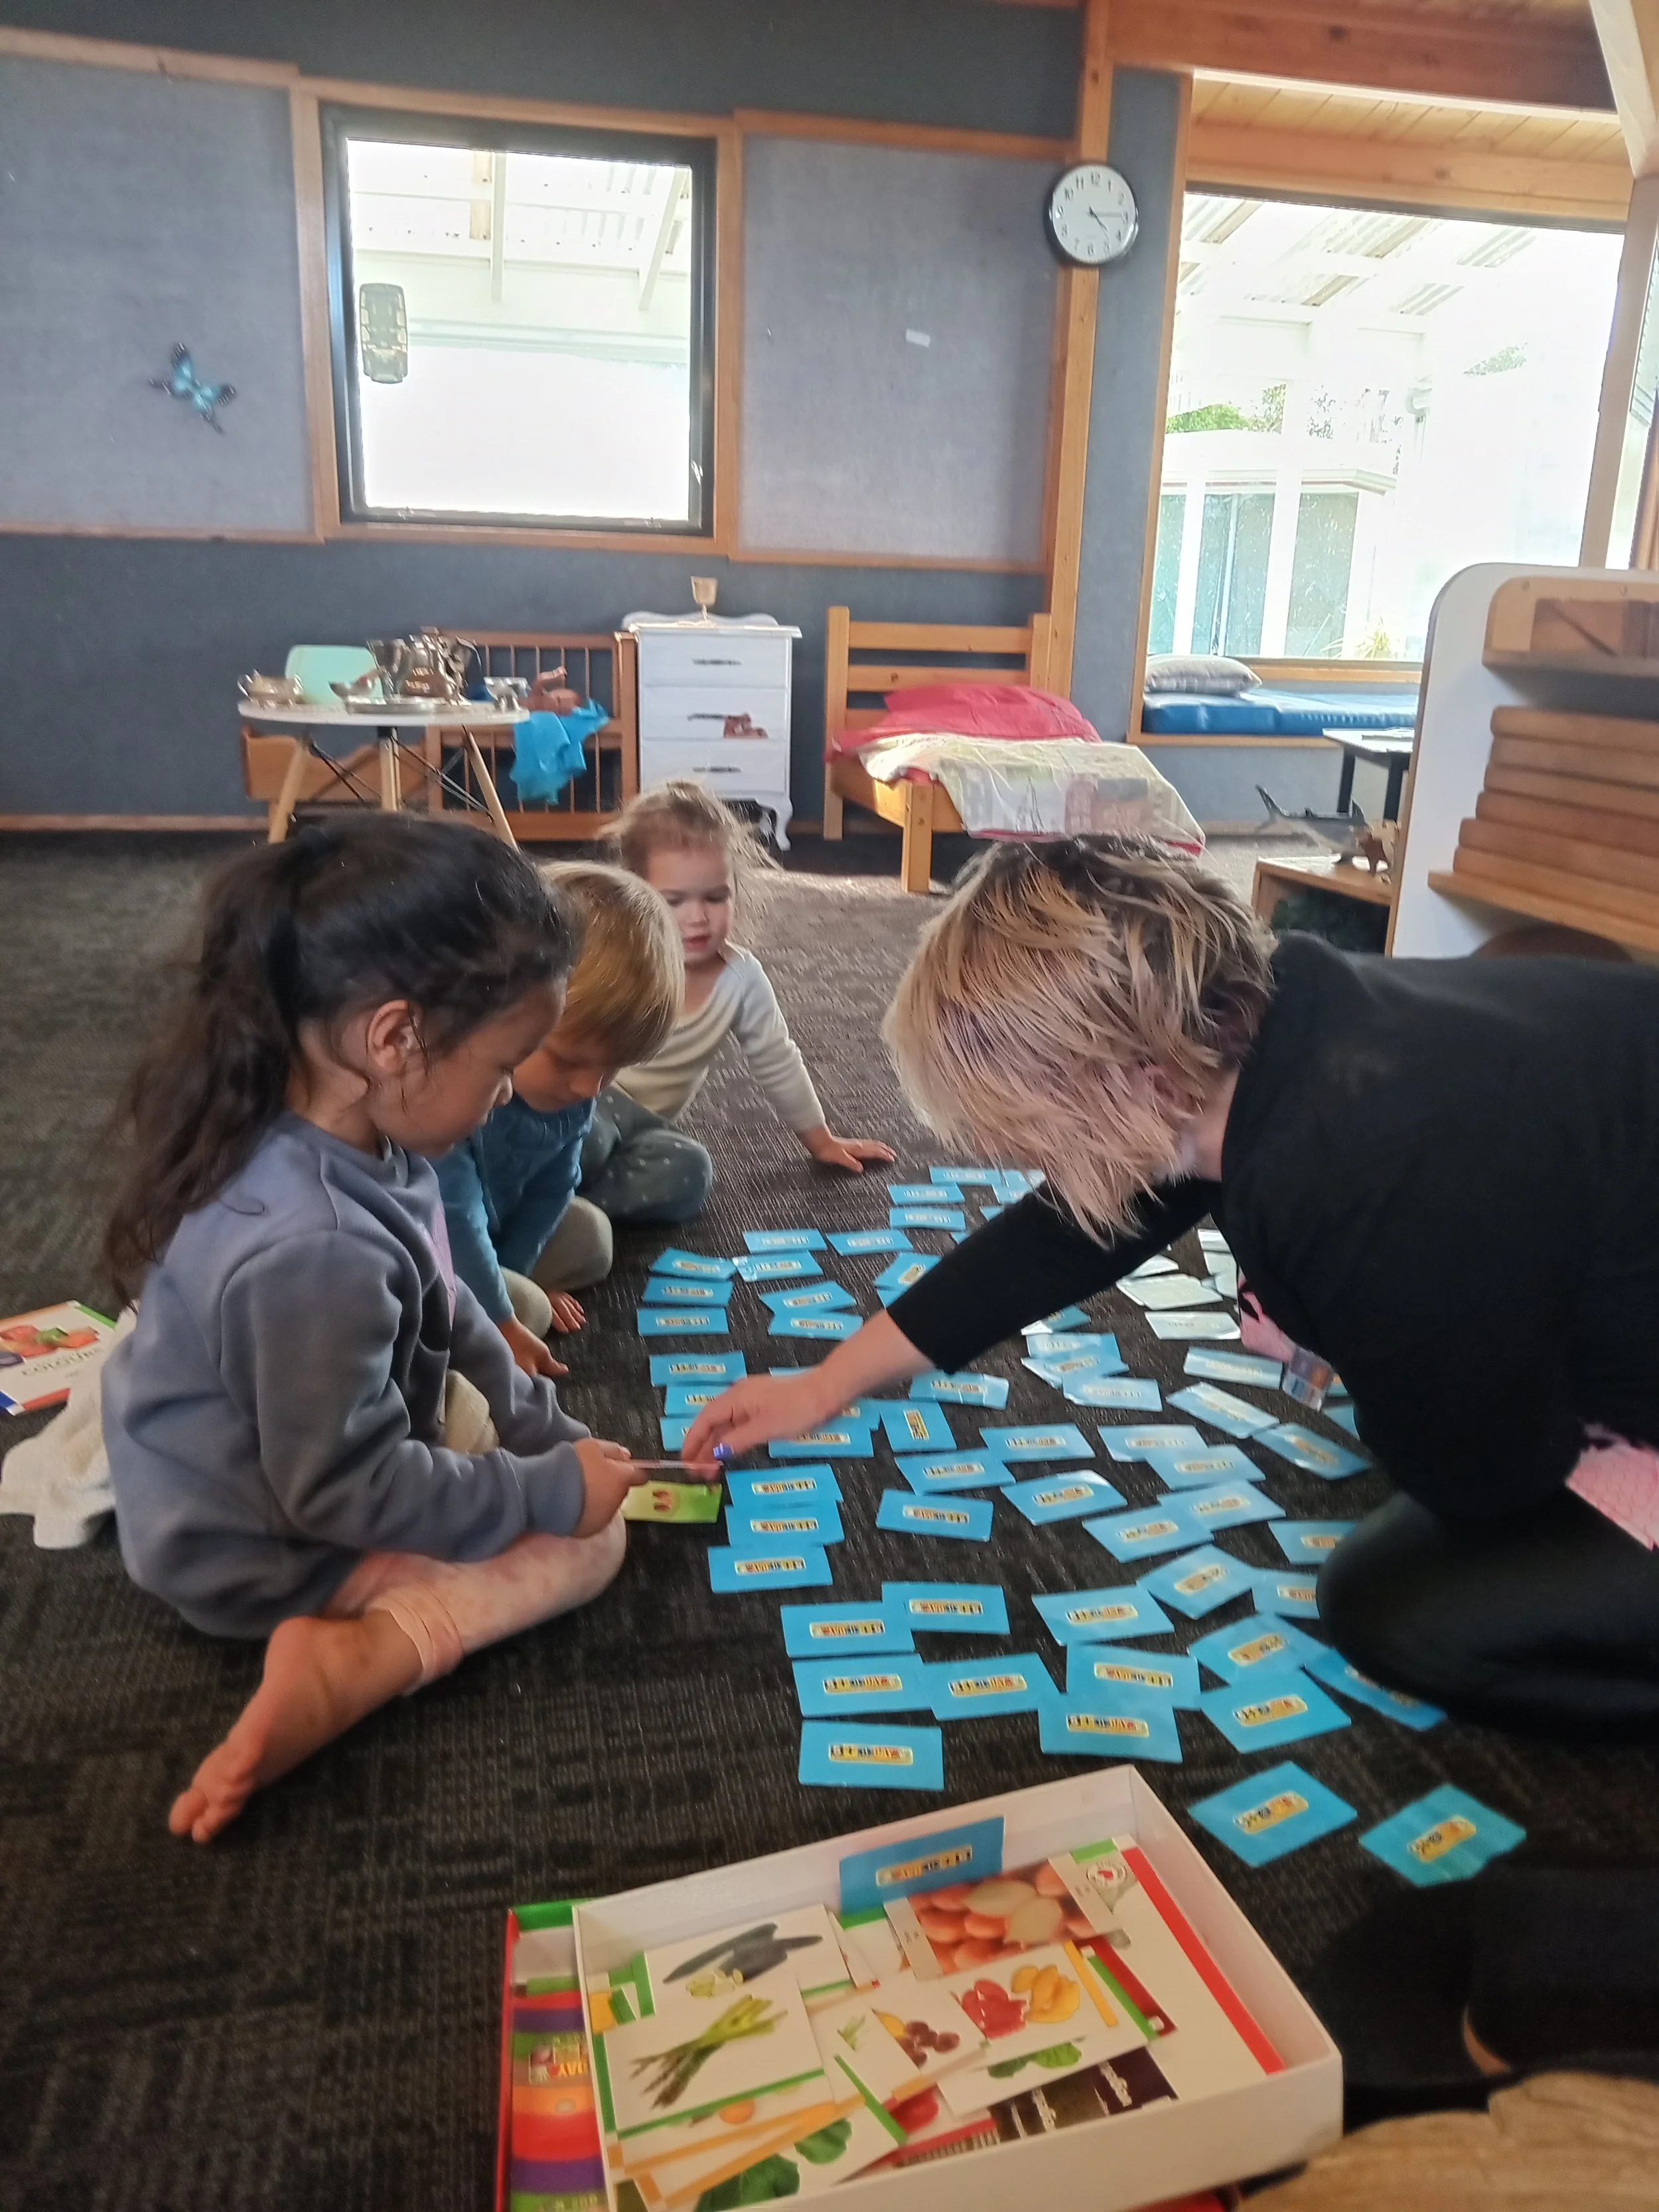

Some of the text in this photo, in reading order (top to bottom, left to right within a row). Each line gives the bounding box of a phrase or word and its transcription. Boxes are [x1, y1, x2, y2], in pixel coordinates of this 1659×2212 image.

[1075, 175, 1084, 190] 11
[1091, 171, 1101, 186] 12
[1107, 179, 1112, 192] 1
[1064, 187, 1074, 202] 10
